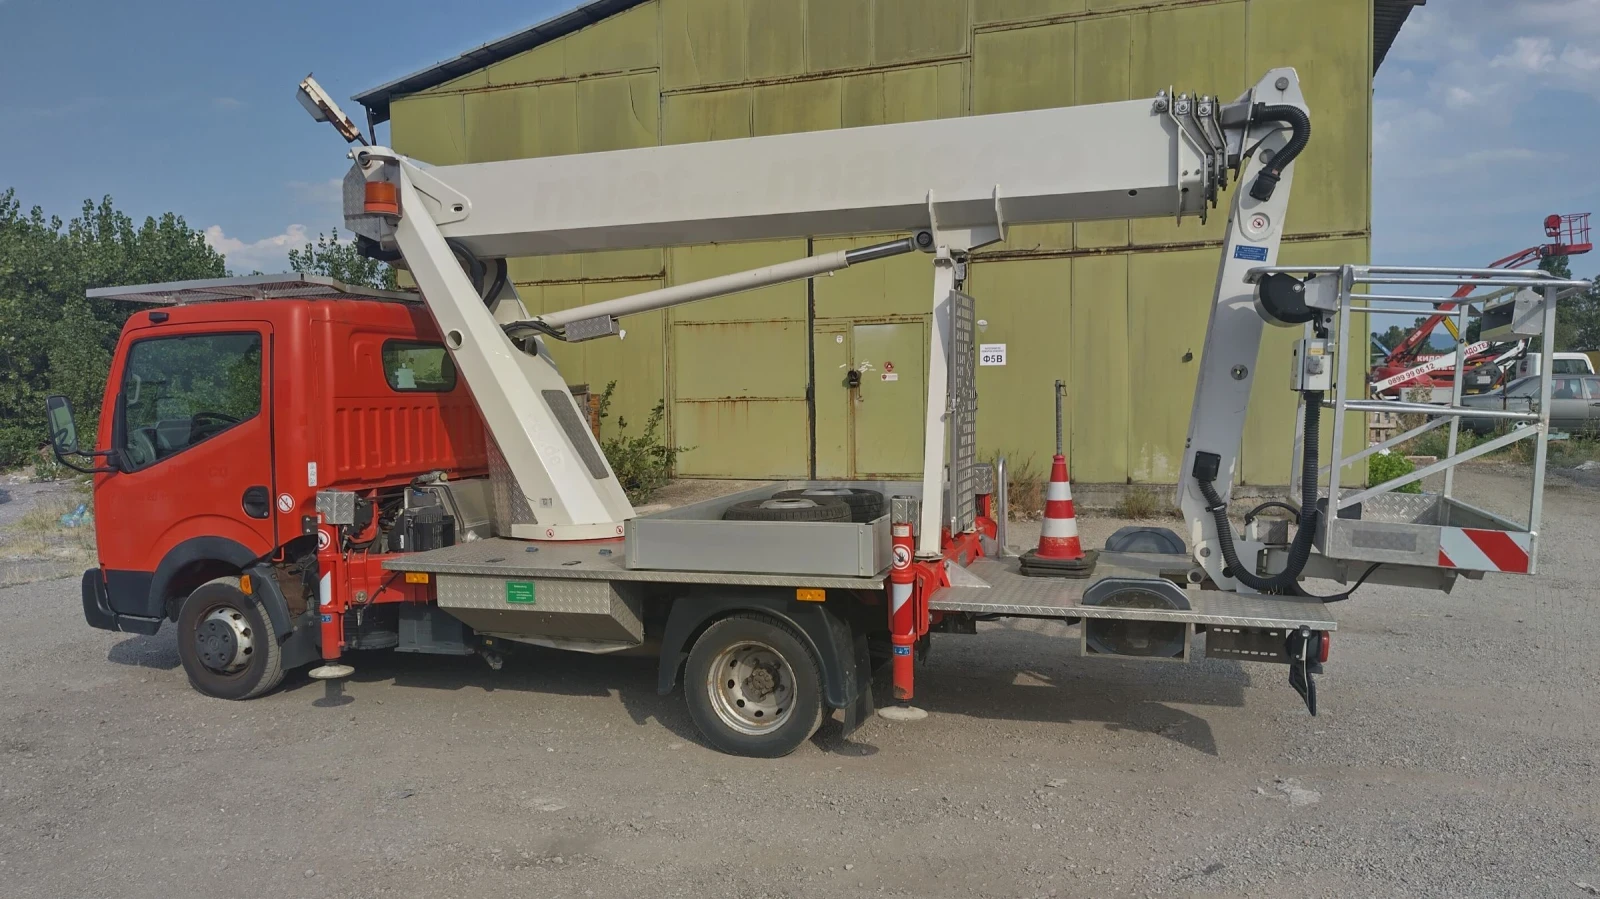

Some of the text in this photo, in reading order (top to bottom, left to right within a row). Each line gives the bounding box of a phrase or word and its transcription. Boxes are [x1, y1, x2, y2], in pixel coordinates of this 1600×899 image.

[983, 354, 1003, 363] Ф5В
[1388, 374, 1405, 385] 0899
[1406, 371, 1415, 379] 99
[1425, 363, 1434, 371] 12
[1463, 346, 1478, 355] ИДО
